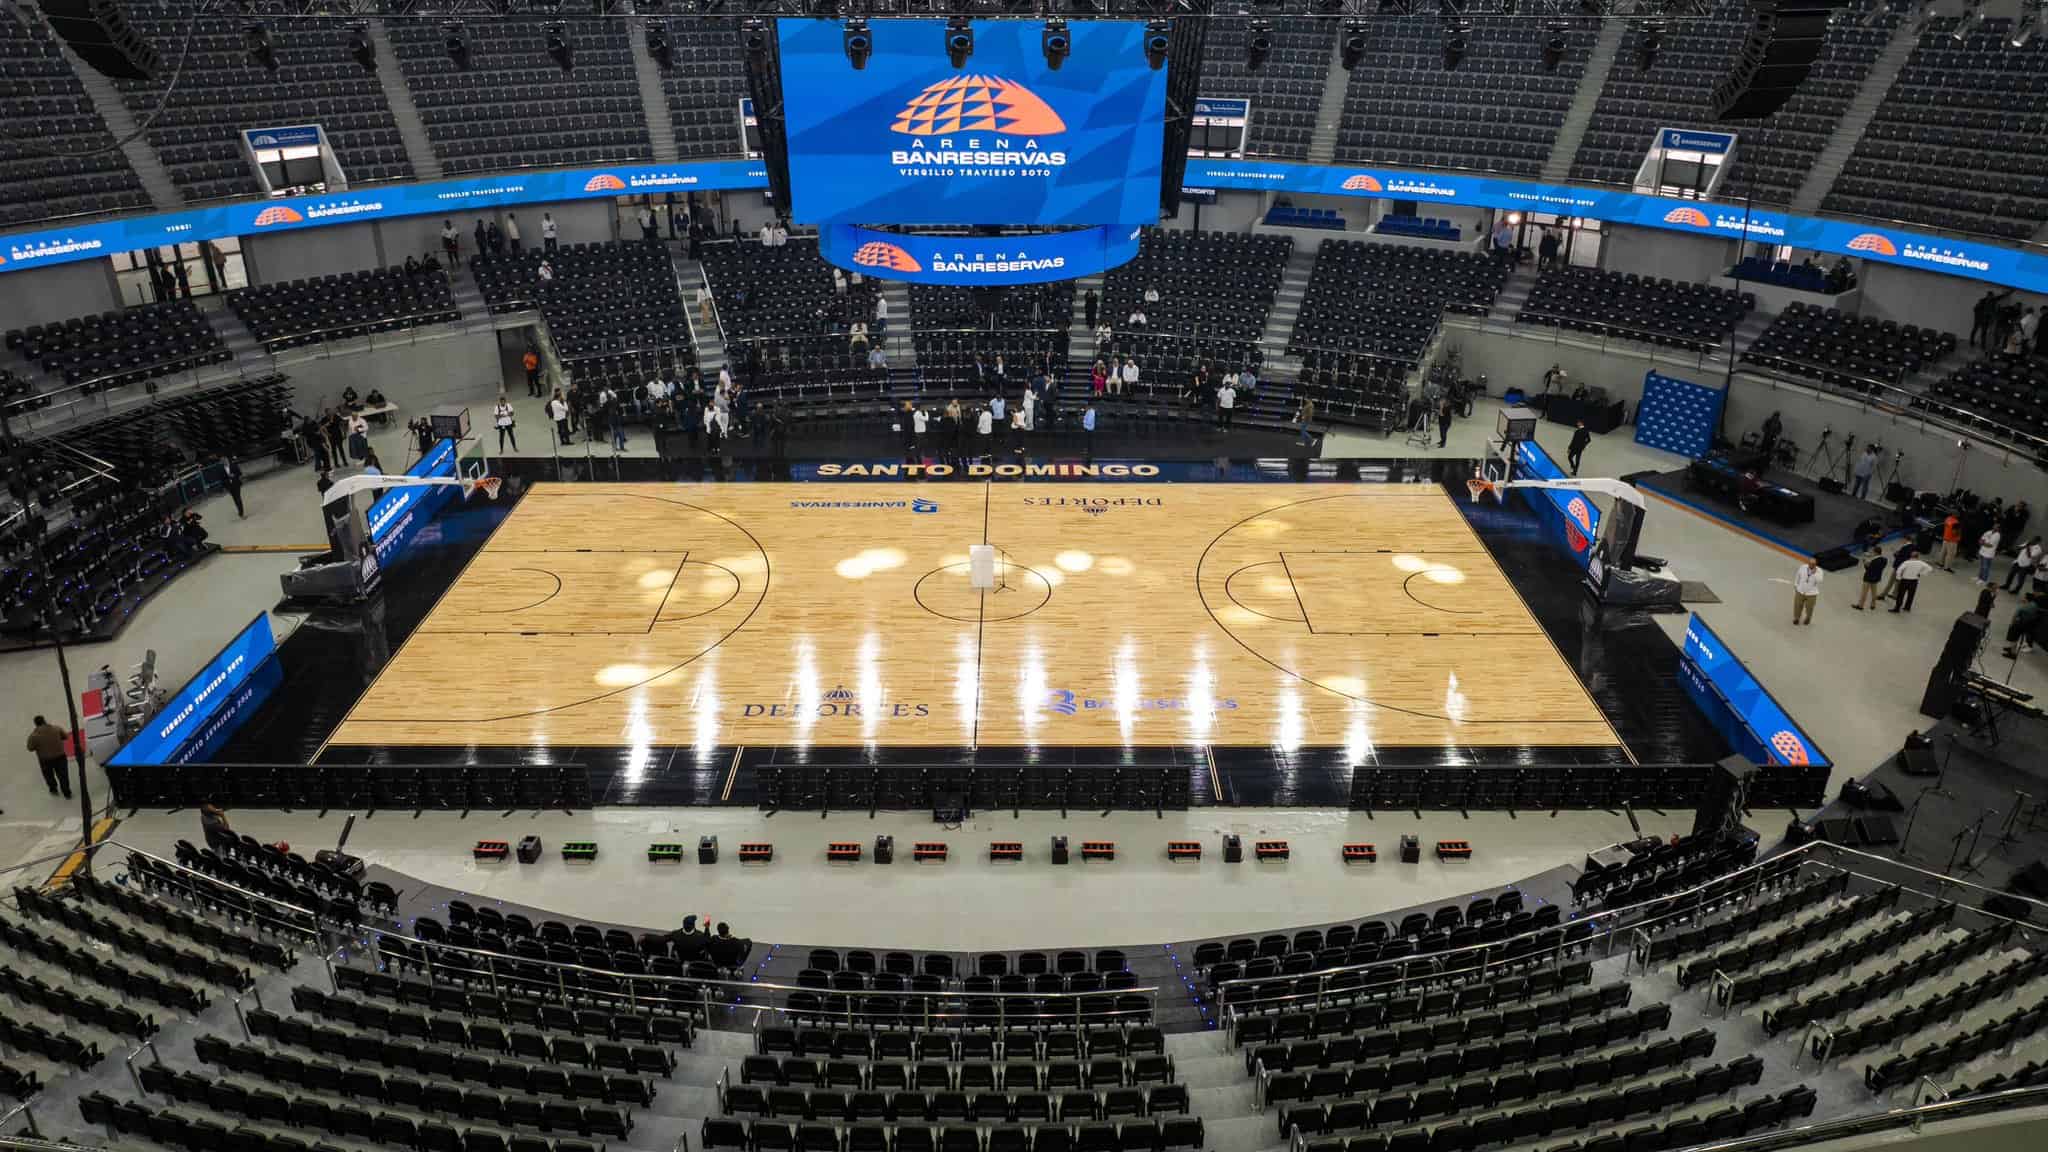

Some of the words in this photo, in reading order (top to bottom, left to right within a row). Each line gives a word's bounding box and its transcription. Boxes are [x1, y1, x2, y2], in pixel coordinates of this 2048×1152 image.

[911, 138, 1038, 149] ARENA
[892, 151, 1066, 166] BANRESERVAS
[900, 169, 954, 177] VIRGILIO
[959, 169, 1016, 177] TRAVIESO
[1021, 169, 1051, 177] SOTO
[1387, 185, 1456, 196] BANRESERVAS
[307, 202, 382, 218] BANRESERVAS
[12, 240, 102, 260] BANRESERVAS
[933, 251, 1027, 261] ARENA
[1905, 243, 1964, 258] ARENA
[933, 257, 1064, 272] BANRESERVAS
[1903, 249, 1989, 271] BANRESERVAS
[816, 463, 953, 477] SANTO
[967, 463, 1160, 477] DOMINGO
[1023, 497, 1162, 506] DEPORTES
[160, 703, 193, 738] VIRGILIO
[194, 671, 227, 705] TRAVIESO
[227, 655, 244, 674] SOTO
